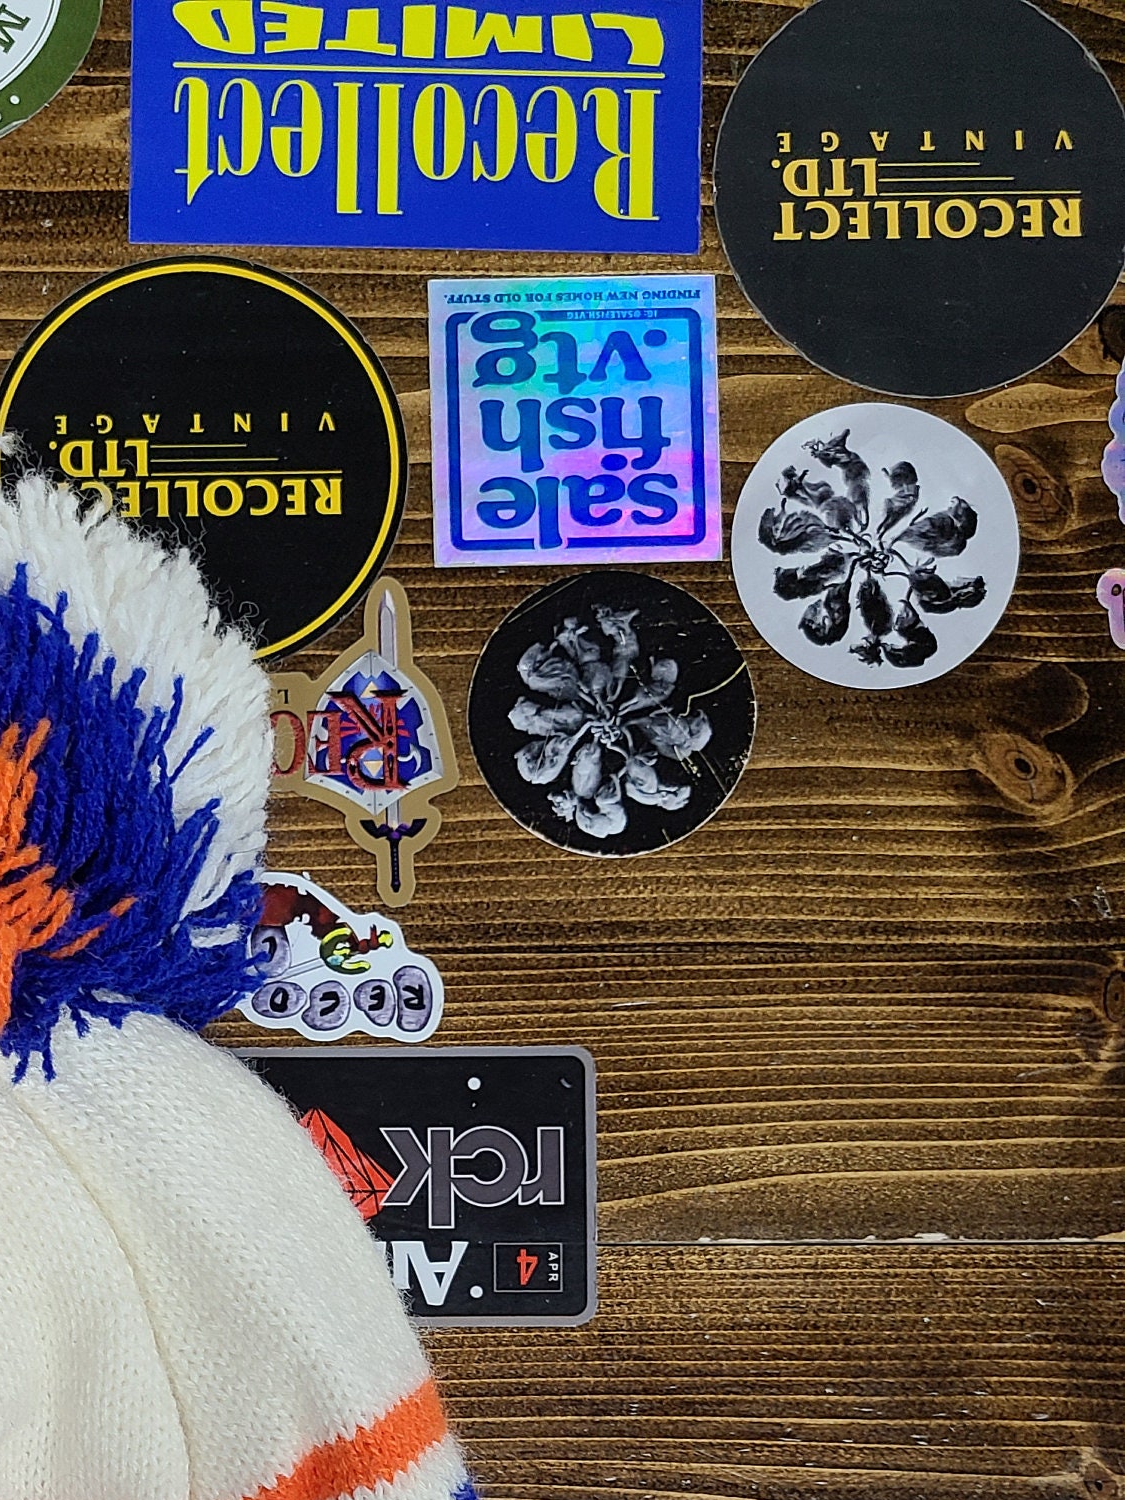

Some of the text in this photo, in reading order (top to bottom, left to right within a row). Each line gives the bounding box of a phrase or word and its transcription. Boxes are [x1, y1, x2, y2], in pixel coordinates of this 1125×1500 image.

[173, 3, 665, 66] LIMITED
[174, 77, 661, 220] Recollect
[776, 130, 1074, 153] VINTAGE
[771, 158, 878, 197] LTD.
[773, 198, 1083, 241] RECOLLECT
[494, 293, 522, 304] OLD
[527, 292, 552, 303] FOR
[557, 291, 603, 303] HOMES
[606, 290, 638, 301] NEW
[643, 289, 701, 300] FINDING
[55, 412, 336, 434] VINTAGE
[479, 396, 671, 472] fish
[49, 440, 150, 477] LTD.
[57, 479, 343, 517] RECOLLEC
[476, 473, 678, 549] sale
[379, 1126, 564, 1229] rck
[516, 1249, 538, 1286] 4
[548, 1251, 560, 1283] APR
